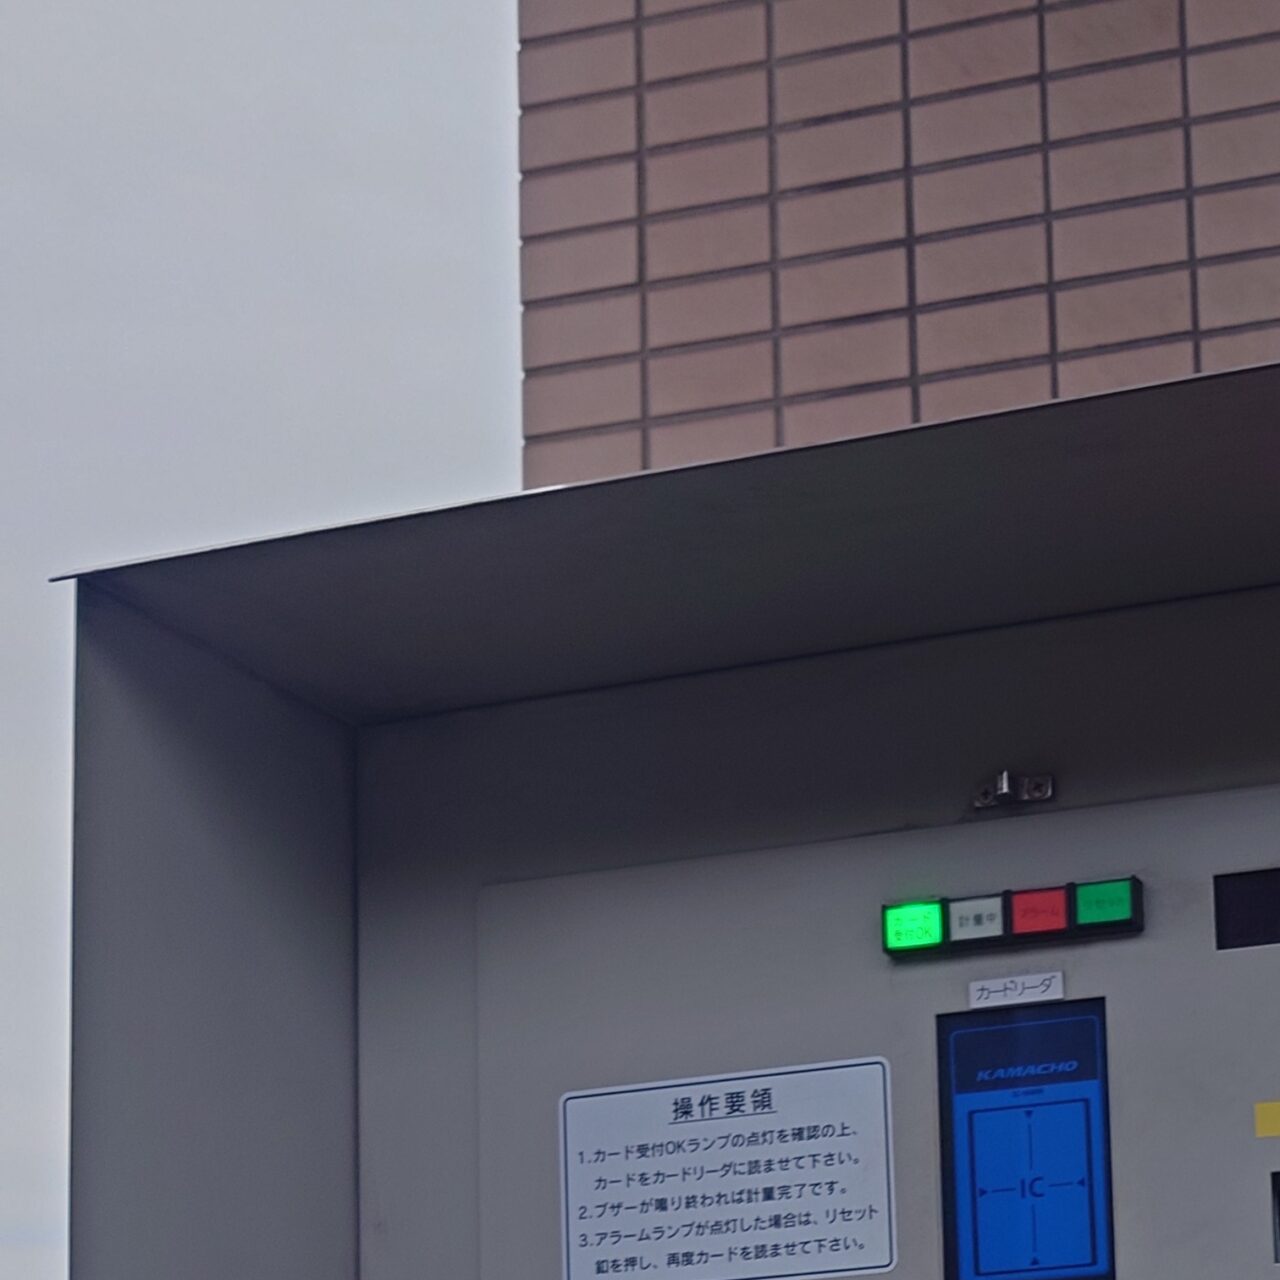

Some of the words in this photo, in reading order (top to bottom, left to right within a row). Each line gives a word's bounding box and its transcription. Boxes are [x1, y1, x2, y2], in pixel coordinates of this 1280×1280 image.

[975, 975, 1057, 1001] カードリーダ
[976, 1060, 1079, 1082] KAMACHO
[671, 1086, 775, 1121] 操作要領
[594, 1152, 861, 1192] カードをカードリーダに読ませて下さい。
[1020, 1176, 1046, 1199] IC
